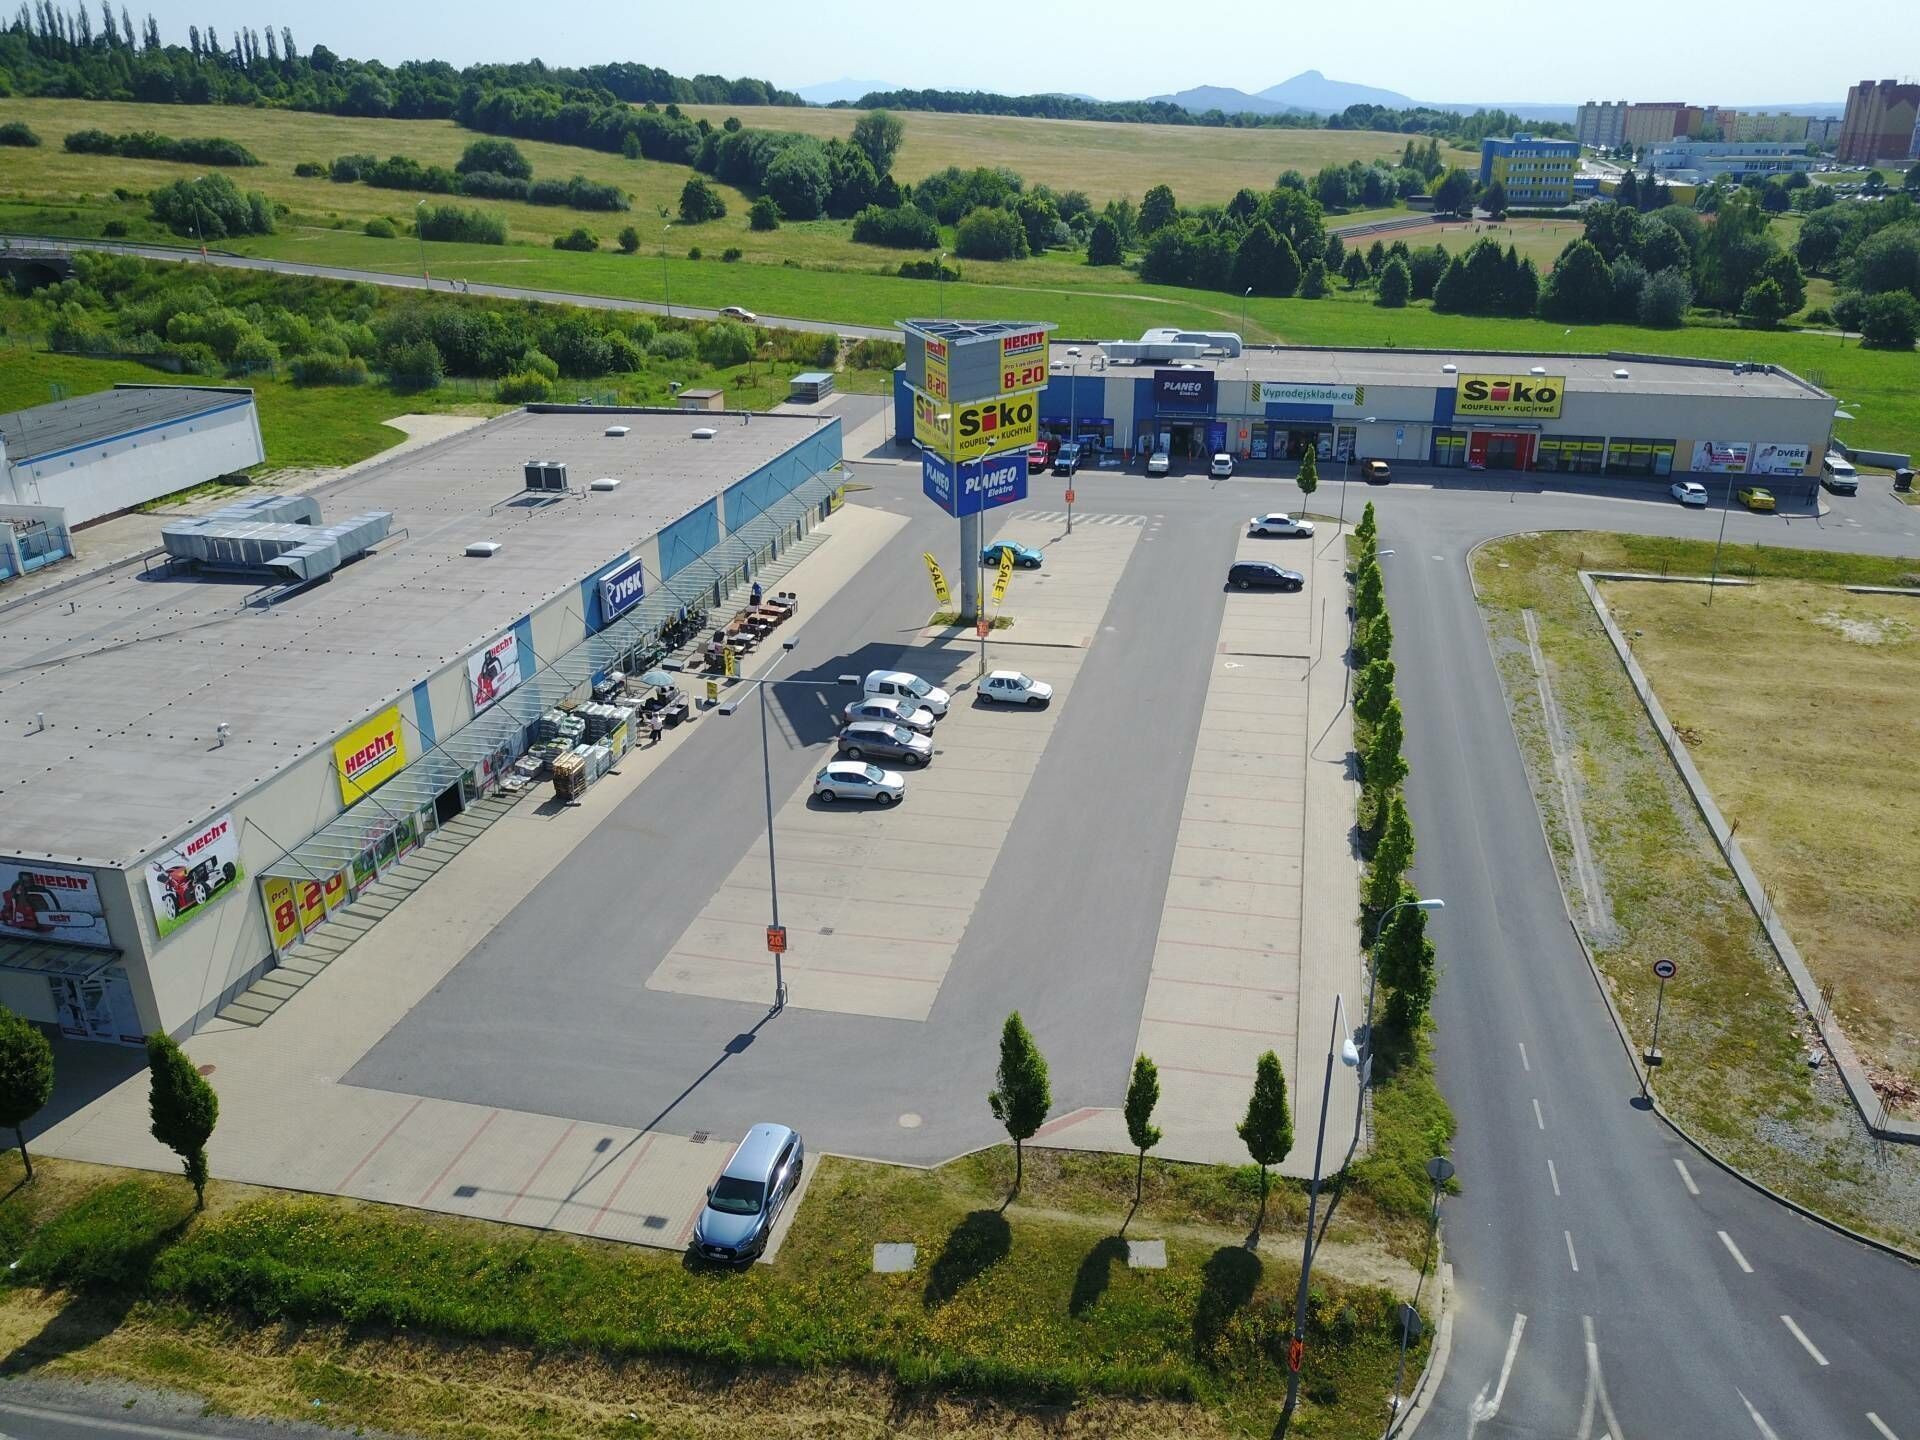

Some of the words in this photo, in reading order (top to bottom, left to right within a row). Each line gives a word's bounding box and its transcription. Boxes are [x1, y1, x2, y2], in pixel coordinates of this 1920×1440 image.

[1005, 366, 1044, 389] 8-20
[1163, 381, 1202, 391] PLANEO
[1263, 388, 1355, 401] Vyprodejskladu.eu
[1461, 403, 1505, 412] KOUPELNY
[965, 466, 1017, 495] PLANEO
[988, 485, 1014, 498] Elektro
[615, 570, 642, 603] JYSK
[930, 566, 946, 595] SALE
[995, 563, 1010, 593] SALE
[271, 887, 288, 903] Pro
